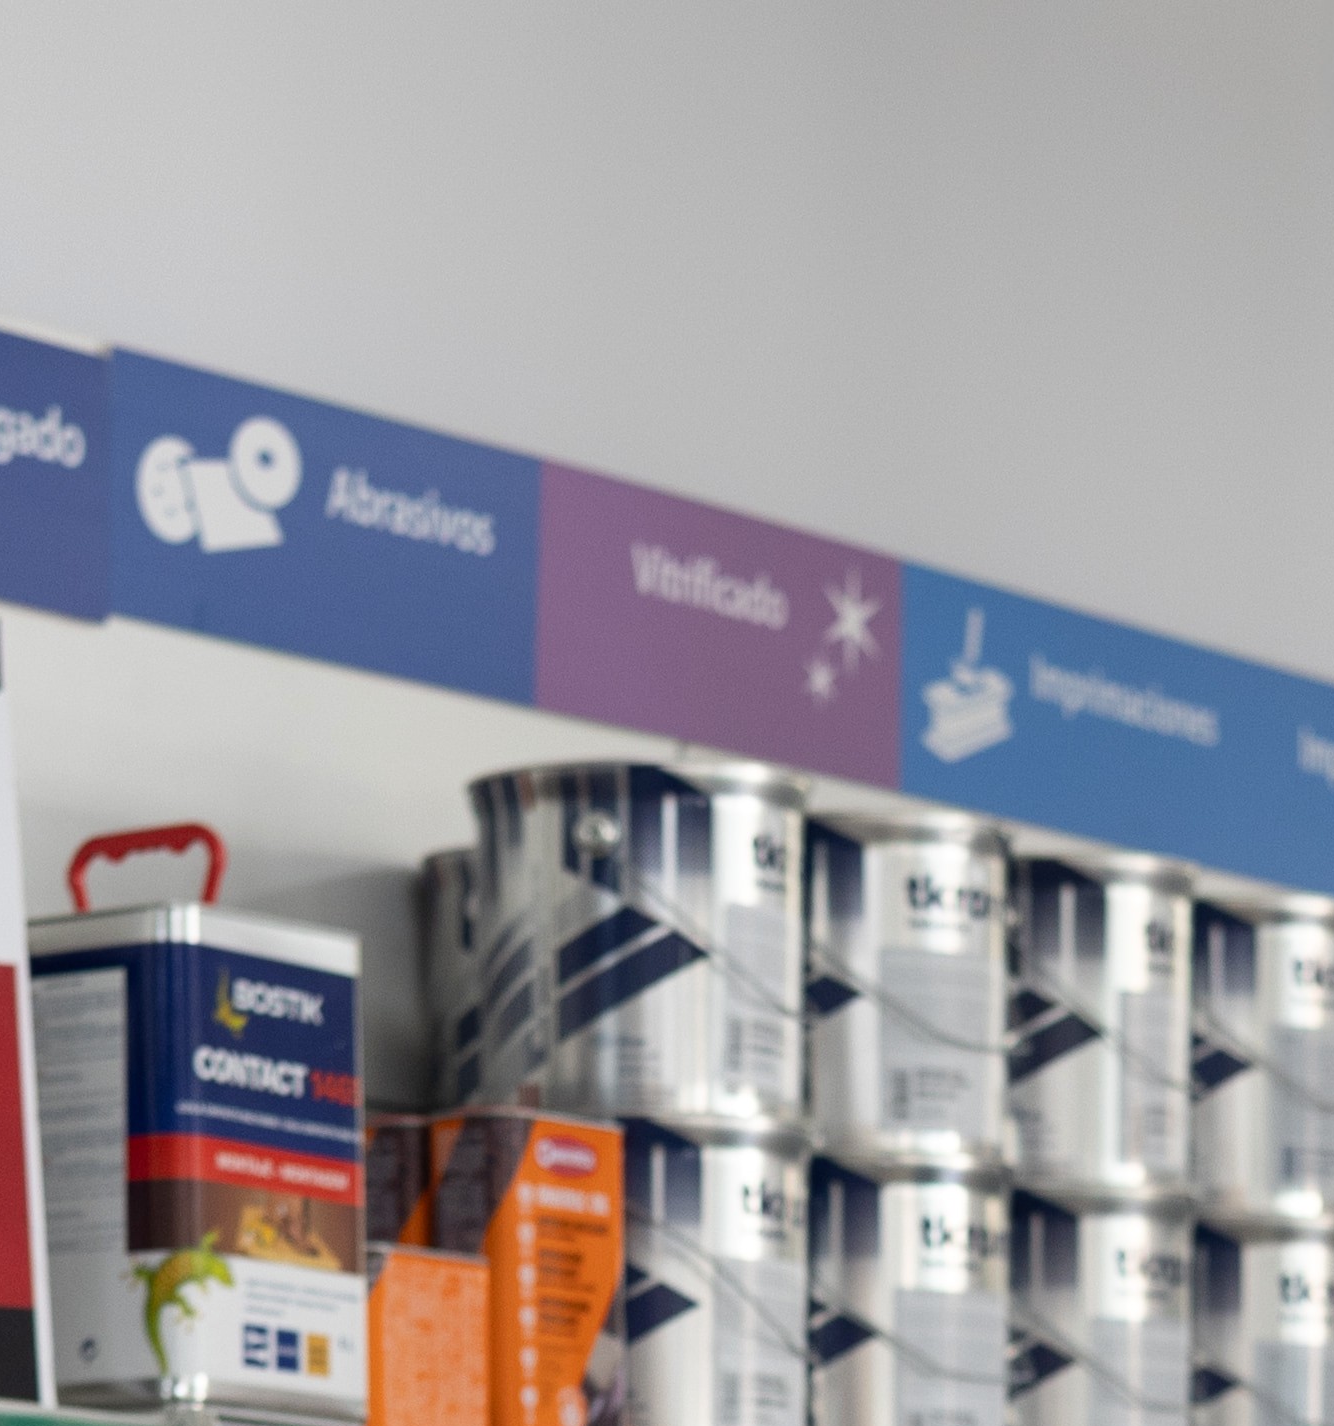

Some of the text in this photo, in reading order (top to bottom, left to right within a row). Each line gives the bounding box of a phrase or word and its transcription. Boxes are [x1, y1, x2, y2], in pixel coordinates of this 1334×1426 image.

[326, 466, 496, 556] Abrasivos
[630, 542, 788, 630] Vitrificado
[193, 1045, 308, 1098] CONTACT
